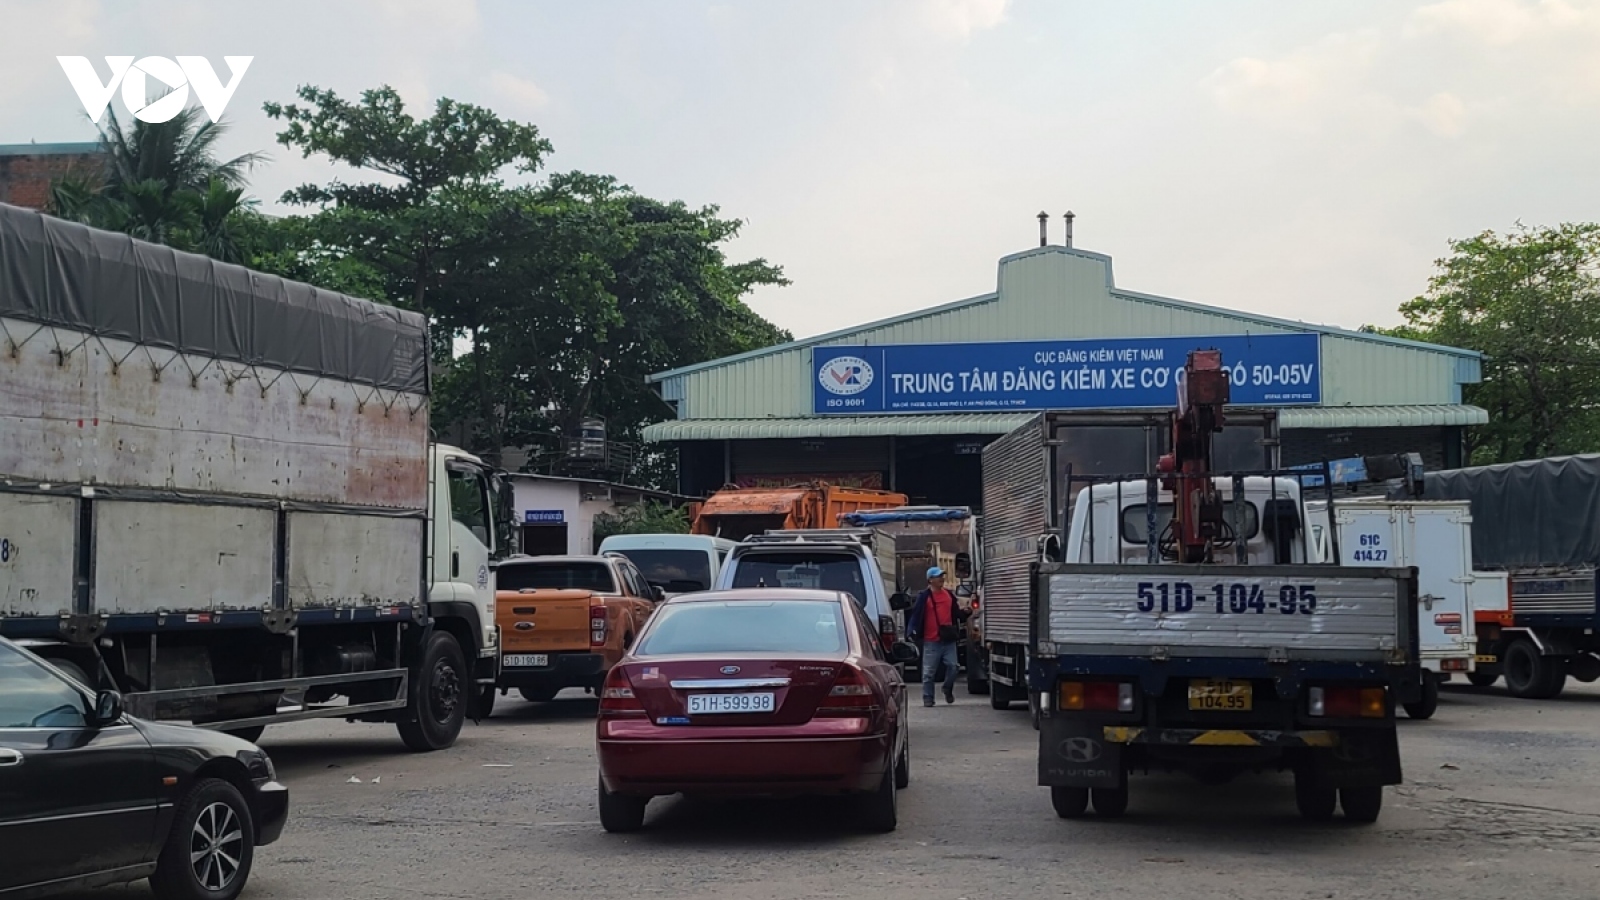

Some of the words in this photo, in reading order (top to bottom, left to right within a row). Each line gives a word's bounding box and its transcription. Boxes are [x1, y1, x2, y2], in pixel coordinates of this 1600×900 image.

[1034, 351, 1056, 366] CỤC
[1058, 349, 1087, 363] ĐĂNG
[1090, 347, 1113, 362] KIỂM
[1117, 348, 1140, 364] VIỆT
[1141, 349, 1164, 361] NAM
[892, 372, 954, 394] TRUNG
[959, 367, 997, 392] TÂM
[1002, 366, 1056, 392] ĐĂNG
[1061, 364, 1106, 390] KIỂM
[1111, 368, 1136, 389] XE
[1140, 367, 1170, 388] CƠ
[1252, 363, 1314, 386] 50-05V
[826, 398, 843, 407] ISO
[844, 398, 865, 407] 9001
[1360, 534, 1380, 546] 61C
[0, 537, 9, 562] 8
[1353, 549, 1388, 562] 414.27
[1136, 581, 1317, 615] 51D-104-95
[691, 695, 770, 711] 51H-599.98
[1199, 695, 1245, 708] 104.95
